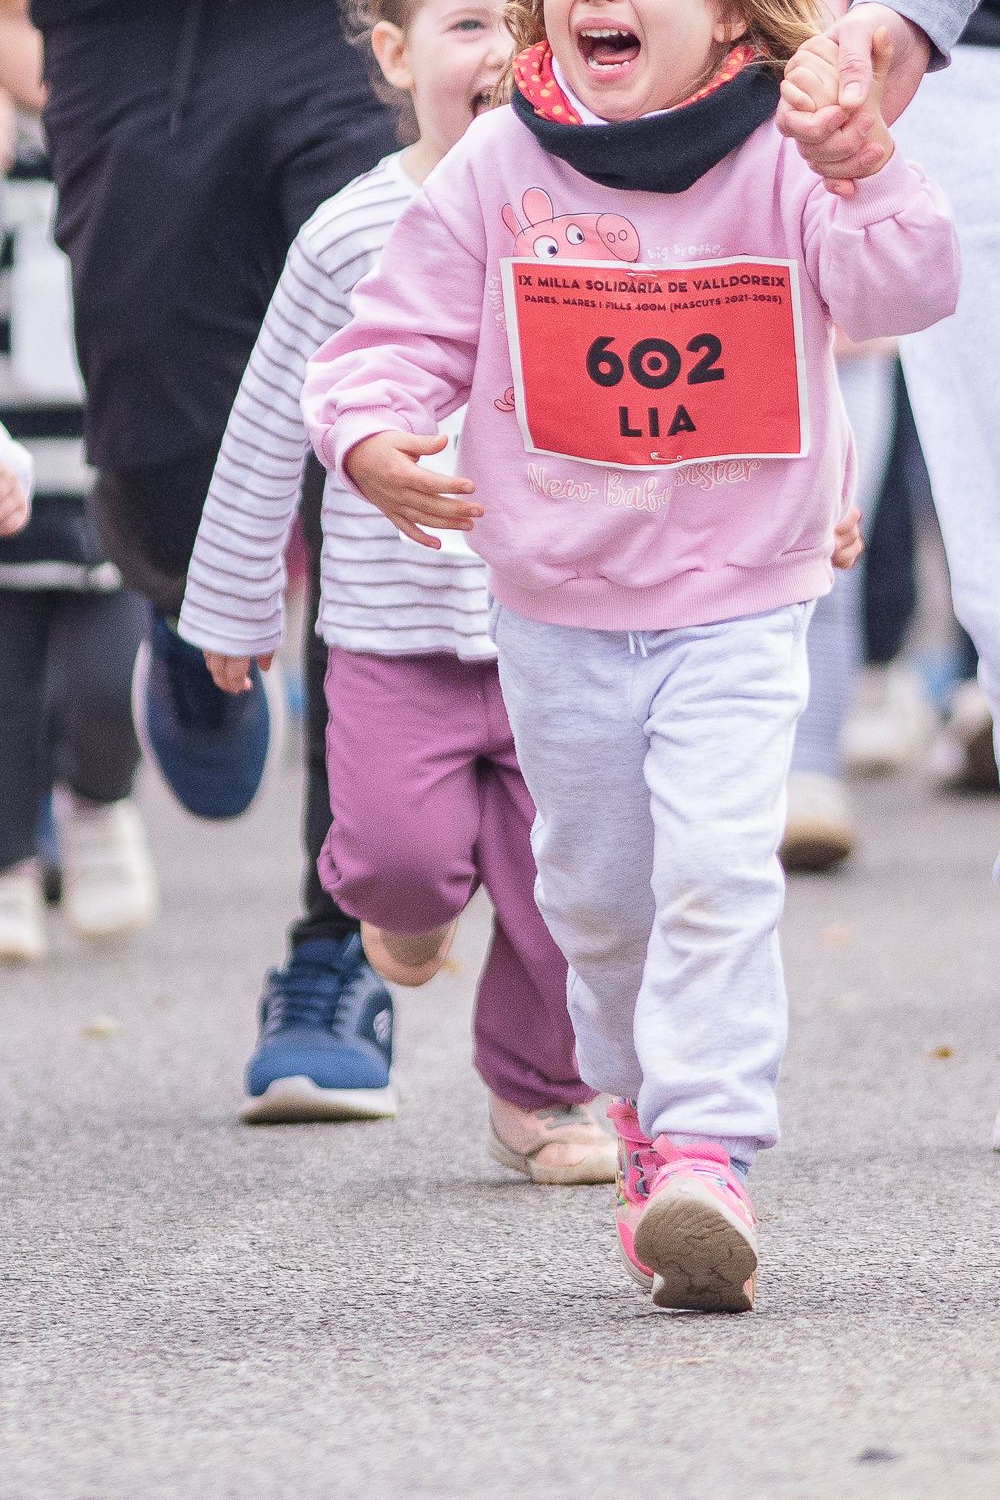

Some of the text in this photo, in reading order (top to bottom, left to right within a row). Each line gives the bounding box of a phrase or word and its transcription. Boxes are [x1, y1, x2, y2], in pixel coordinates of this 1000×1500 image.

[518, 275, 533, 286] IX
[538, 277, 580, 289] MILLA
[668, 282, 688, 293] DE
[693, 274, 786, 291] VALLDOREIX
[563, 298, 596, 308] MARES
[605, 301, 632, 310] FILLS
[635, 302, 667, 312] 400M
[670, 297, 721, 313] (NASCUTS
[724, 293, 782, 305] 2021-2025)
[586, 333, 725, 390] 602
[618, 404, 697, 438] LIA
[527, 463, 598, 502] New
